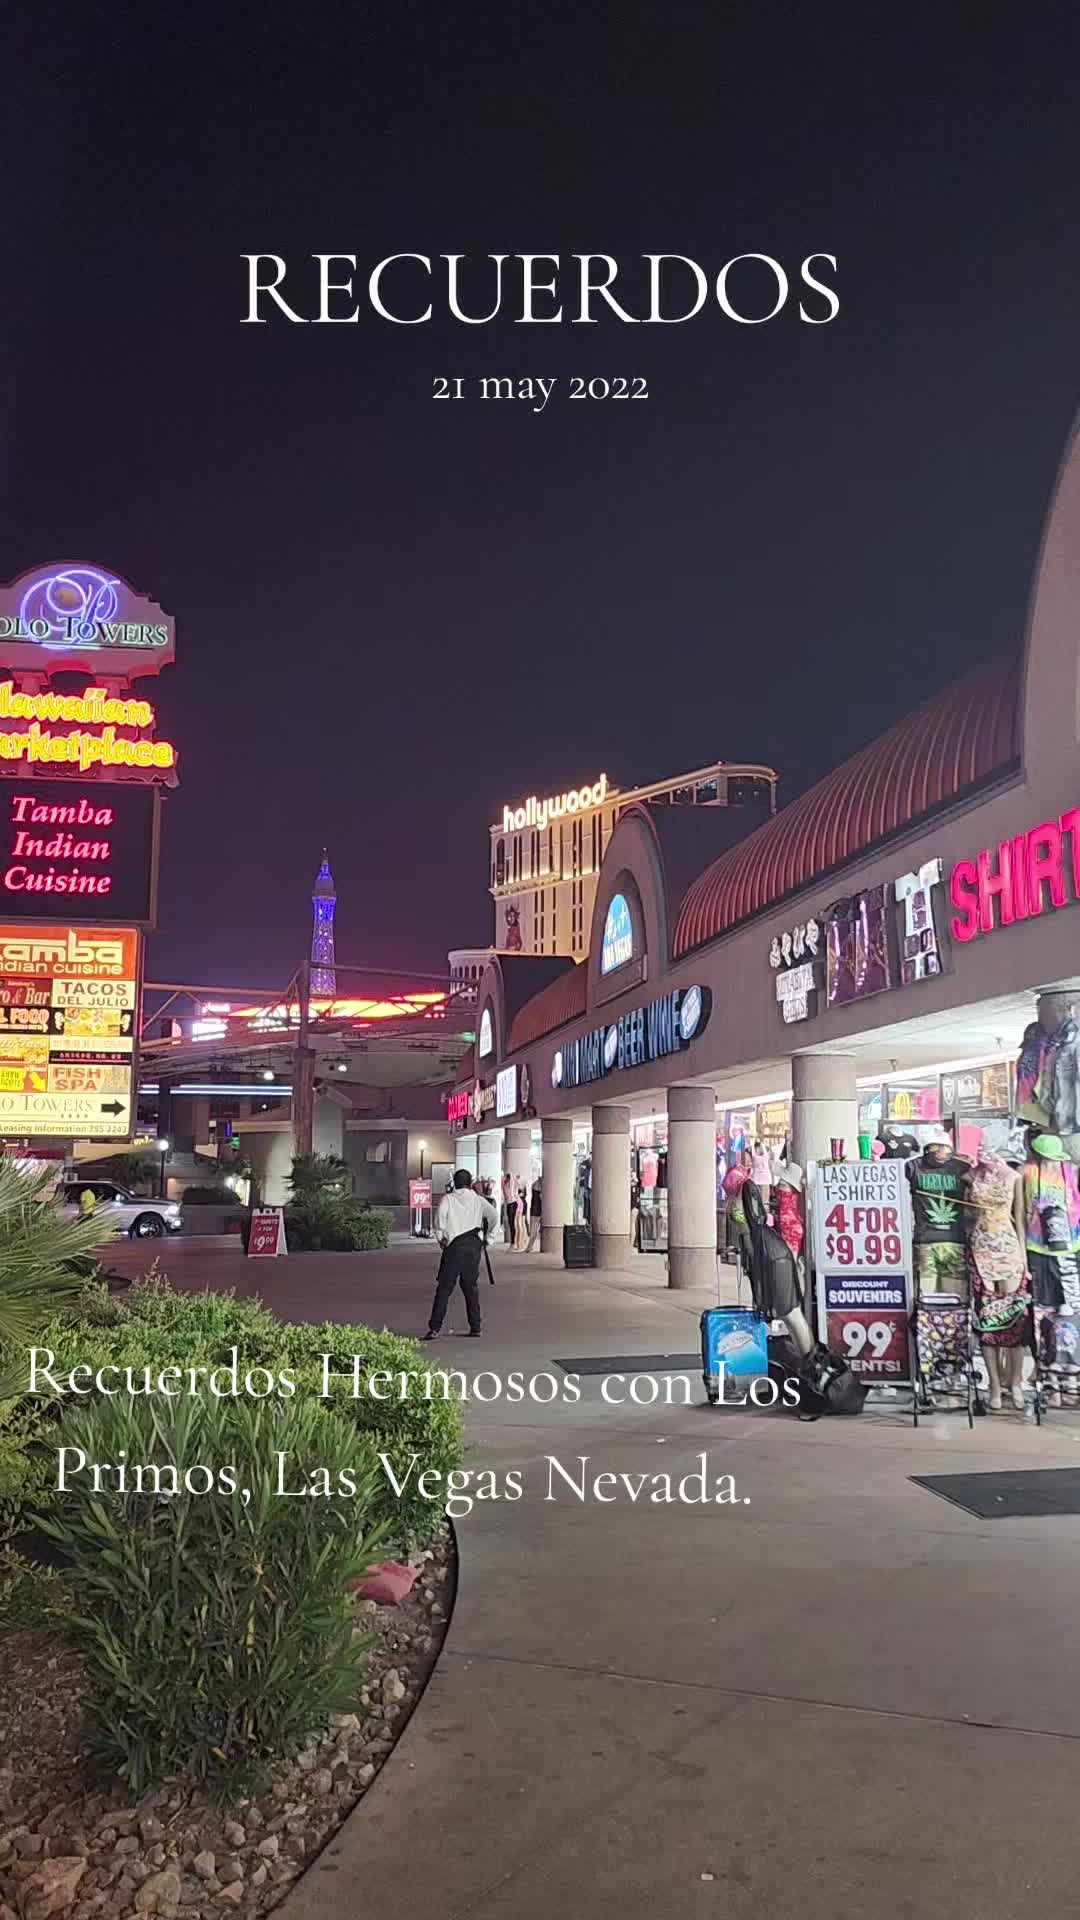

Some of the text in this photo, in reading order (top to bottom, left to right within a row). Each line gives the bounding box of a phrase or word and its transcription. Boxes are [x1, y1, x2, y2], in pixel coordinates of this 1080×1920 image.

[12, 797, 114, 825] Tamba
[503, 773, 607, 833] hollywood
[11, 831, 111, 859] Indian
[4, 866, 112, 893] Cuisine
[24, 987, 50, 1005] Bar
[60, 982, 128, 996] TACOS
[56, 996, 129, 1007] DEL JULIO
[10, 1007, 50, 1025] FOOD
[617, 1006, 647, 1070] BEER
[54, 1067, 102, 1079] FISH
[54, 1079, 97, 1091] SPA
[822, 1164, 849, 1184] LAS
[852, 1164, 898, 1183] VEGAS
[823, 1184, 897, 1201] T-SHIRTS
[824, 1203, 901, 1234] 4 FOR
[825, 1233, 902, 1266] $9.99
[841, 1280, 890, 1289] DISCOUNT
[828, 1290, 904, 1304] SOUVENIRS
[850, 1359, 902, 1373] ENTS!
